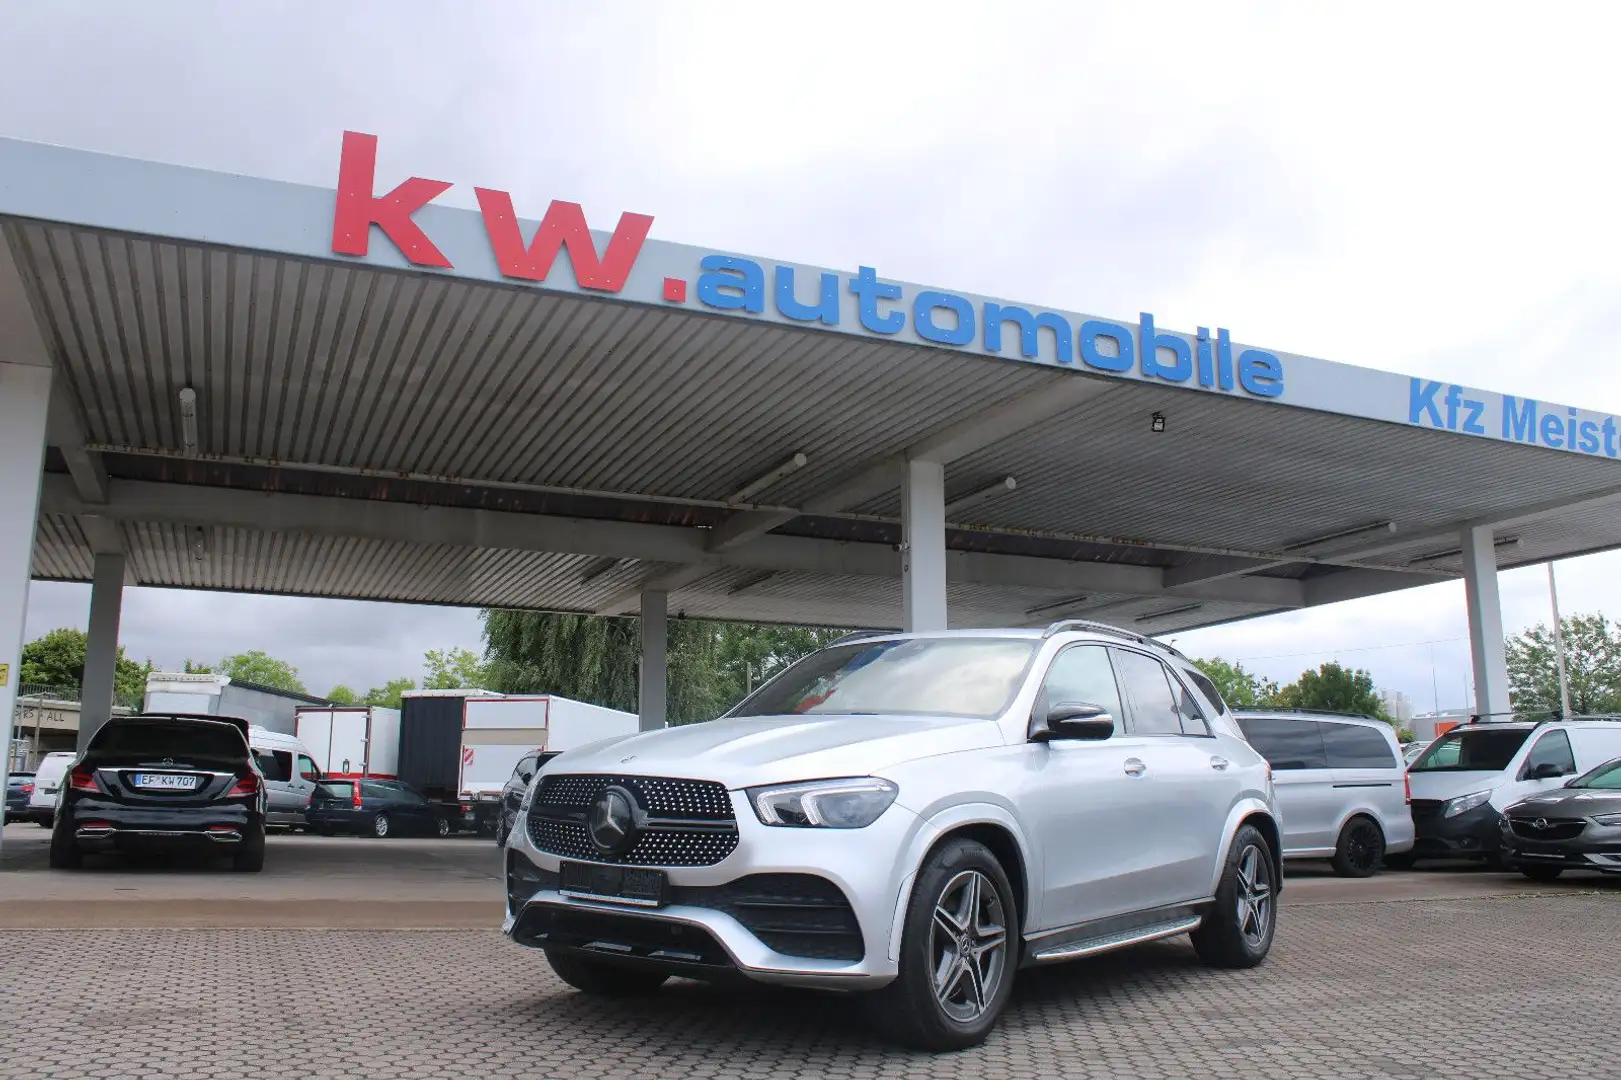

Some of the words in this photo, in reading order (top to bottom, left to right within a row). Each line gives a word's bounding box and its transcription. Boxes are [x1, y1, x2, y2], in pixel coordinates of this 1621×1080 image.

[1409, 377, 1485, 434] Kfz
[1502, 395, 1621, 458] Meist
[46, 711, 65, 722] ALL
[141, 775, 155, 785] EF
